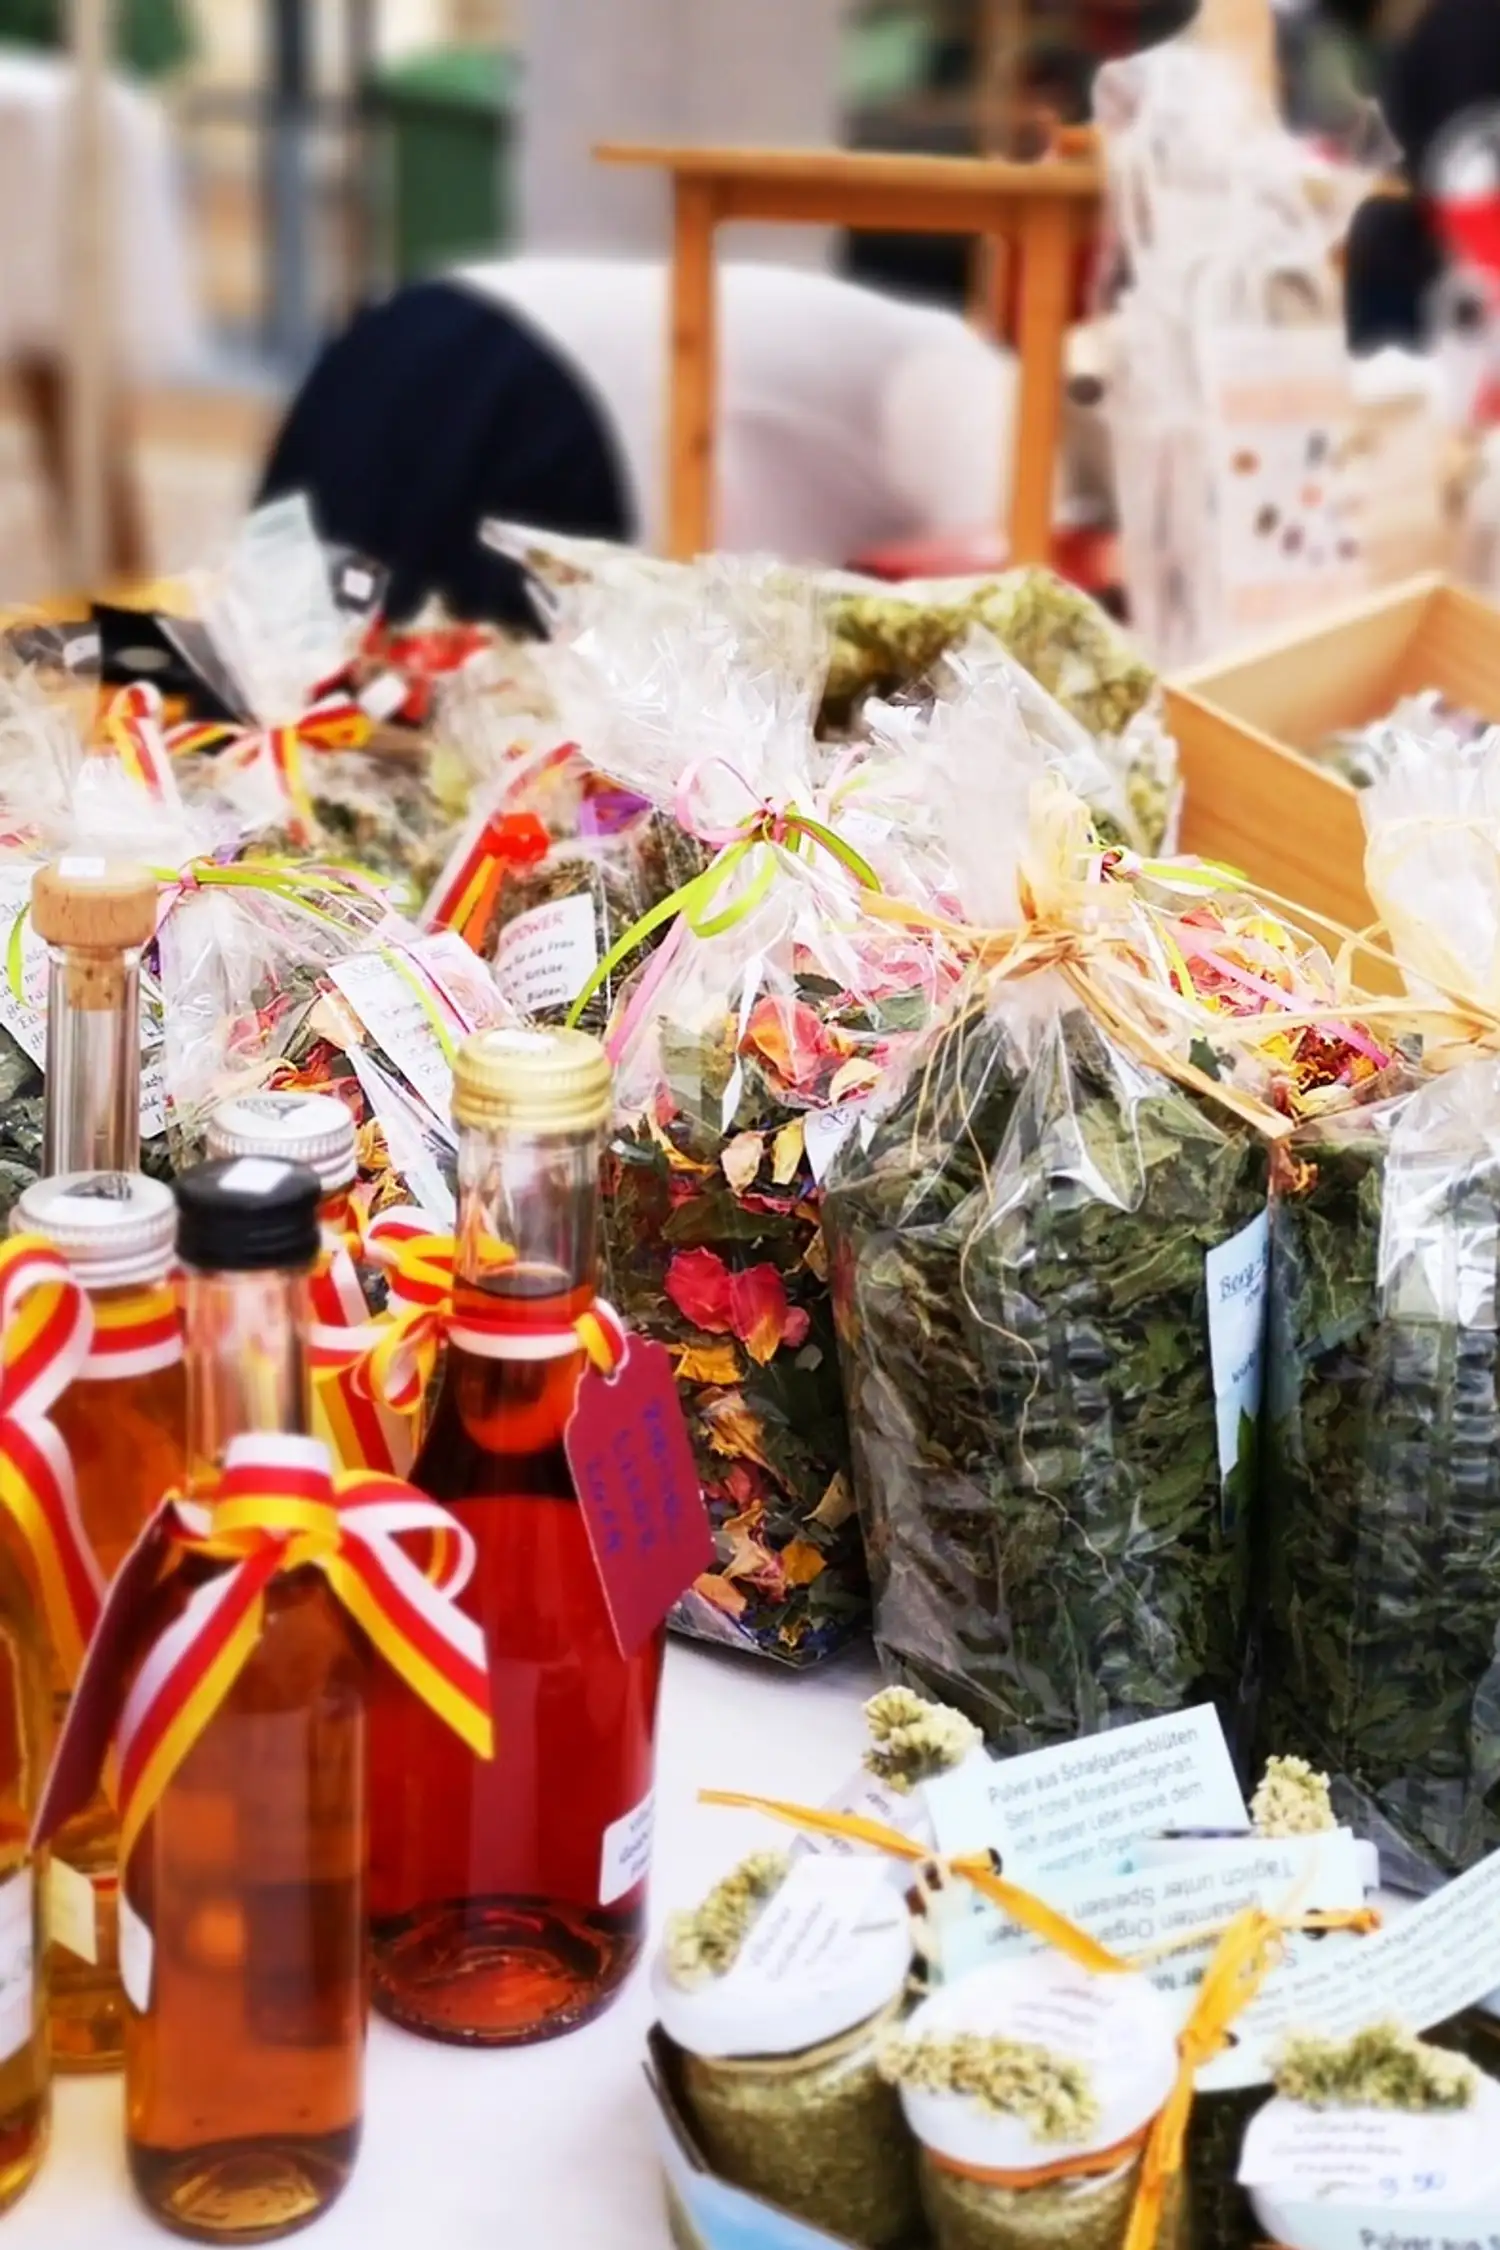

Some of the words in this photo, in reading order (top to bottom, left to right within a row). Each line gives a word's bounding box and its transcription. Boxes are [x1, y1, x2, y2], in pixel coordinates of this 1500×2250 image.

[988, 1778, 1032, 1804] Pulver
[1035, 1772, 1059, 1792] aus
[1060, 1727, 1198, 1782] Schafgarbenblüten
[1128, 1792, 1168, 1818] sowie
[1171, 1780, 1204, 1804] dem
[1164, 1872, 1214, 1898] unter
[1221, 1856, 1295, 1891] Täglich
[1074, 1887, 1157, 1920] Speisen
